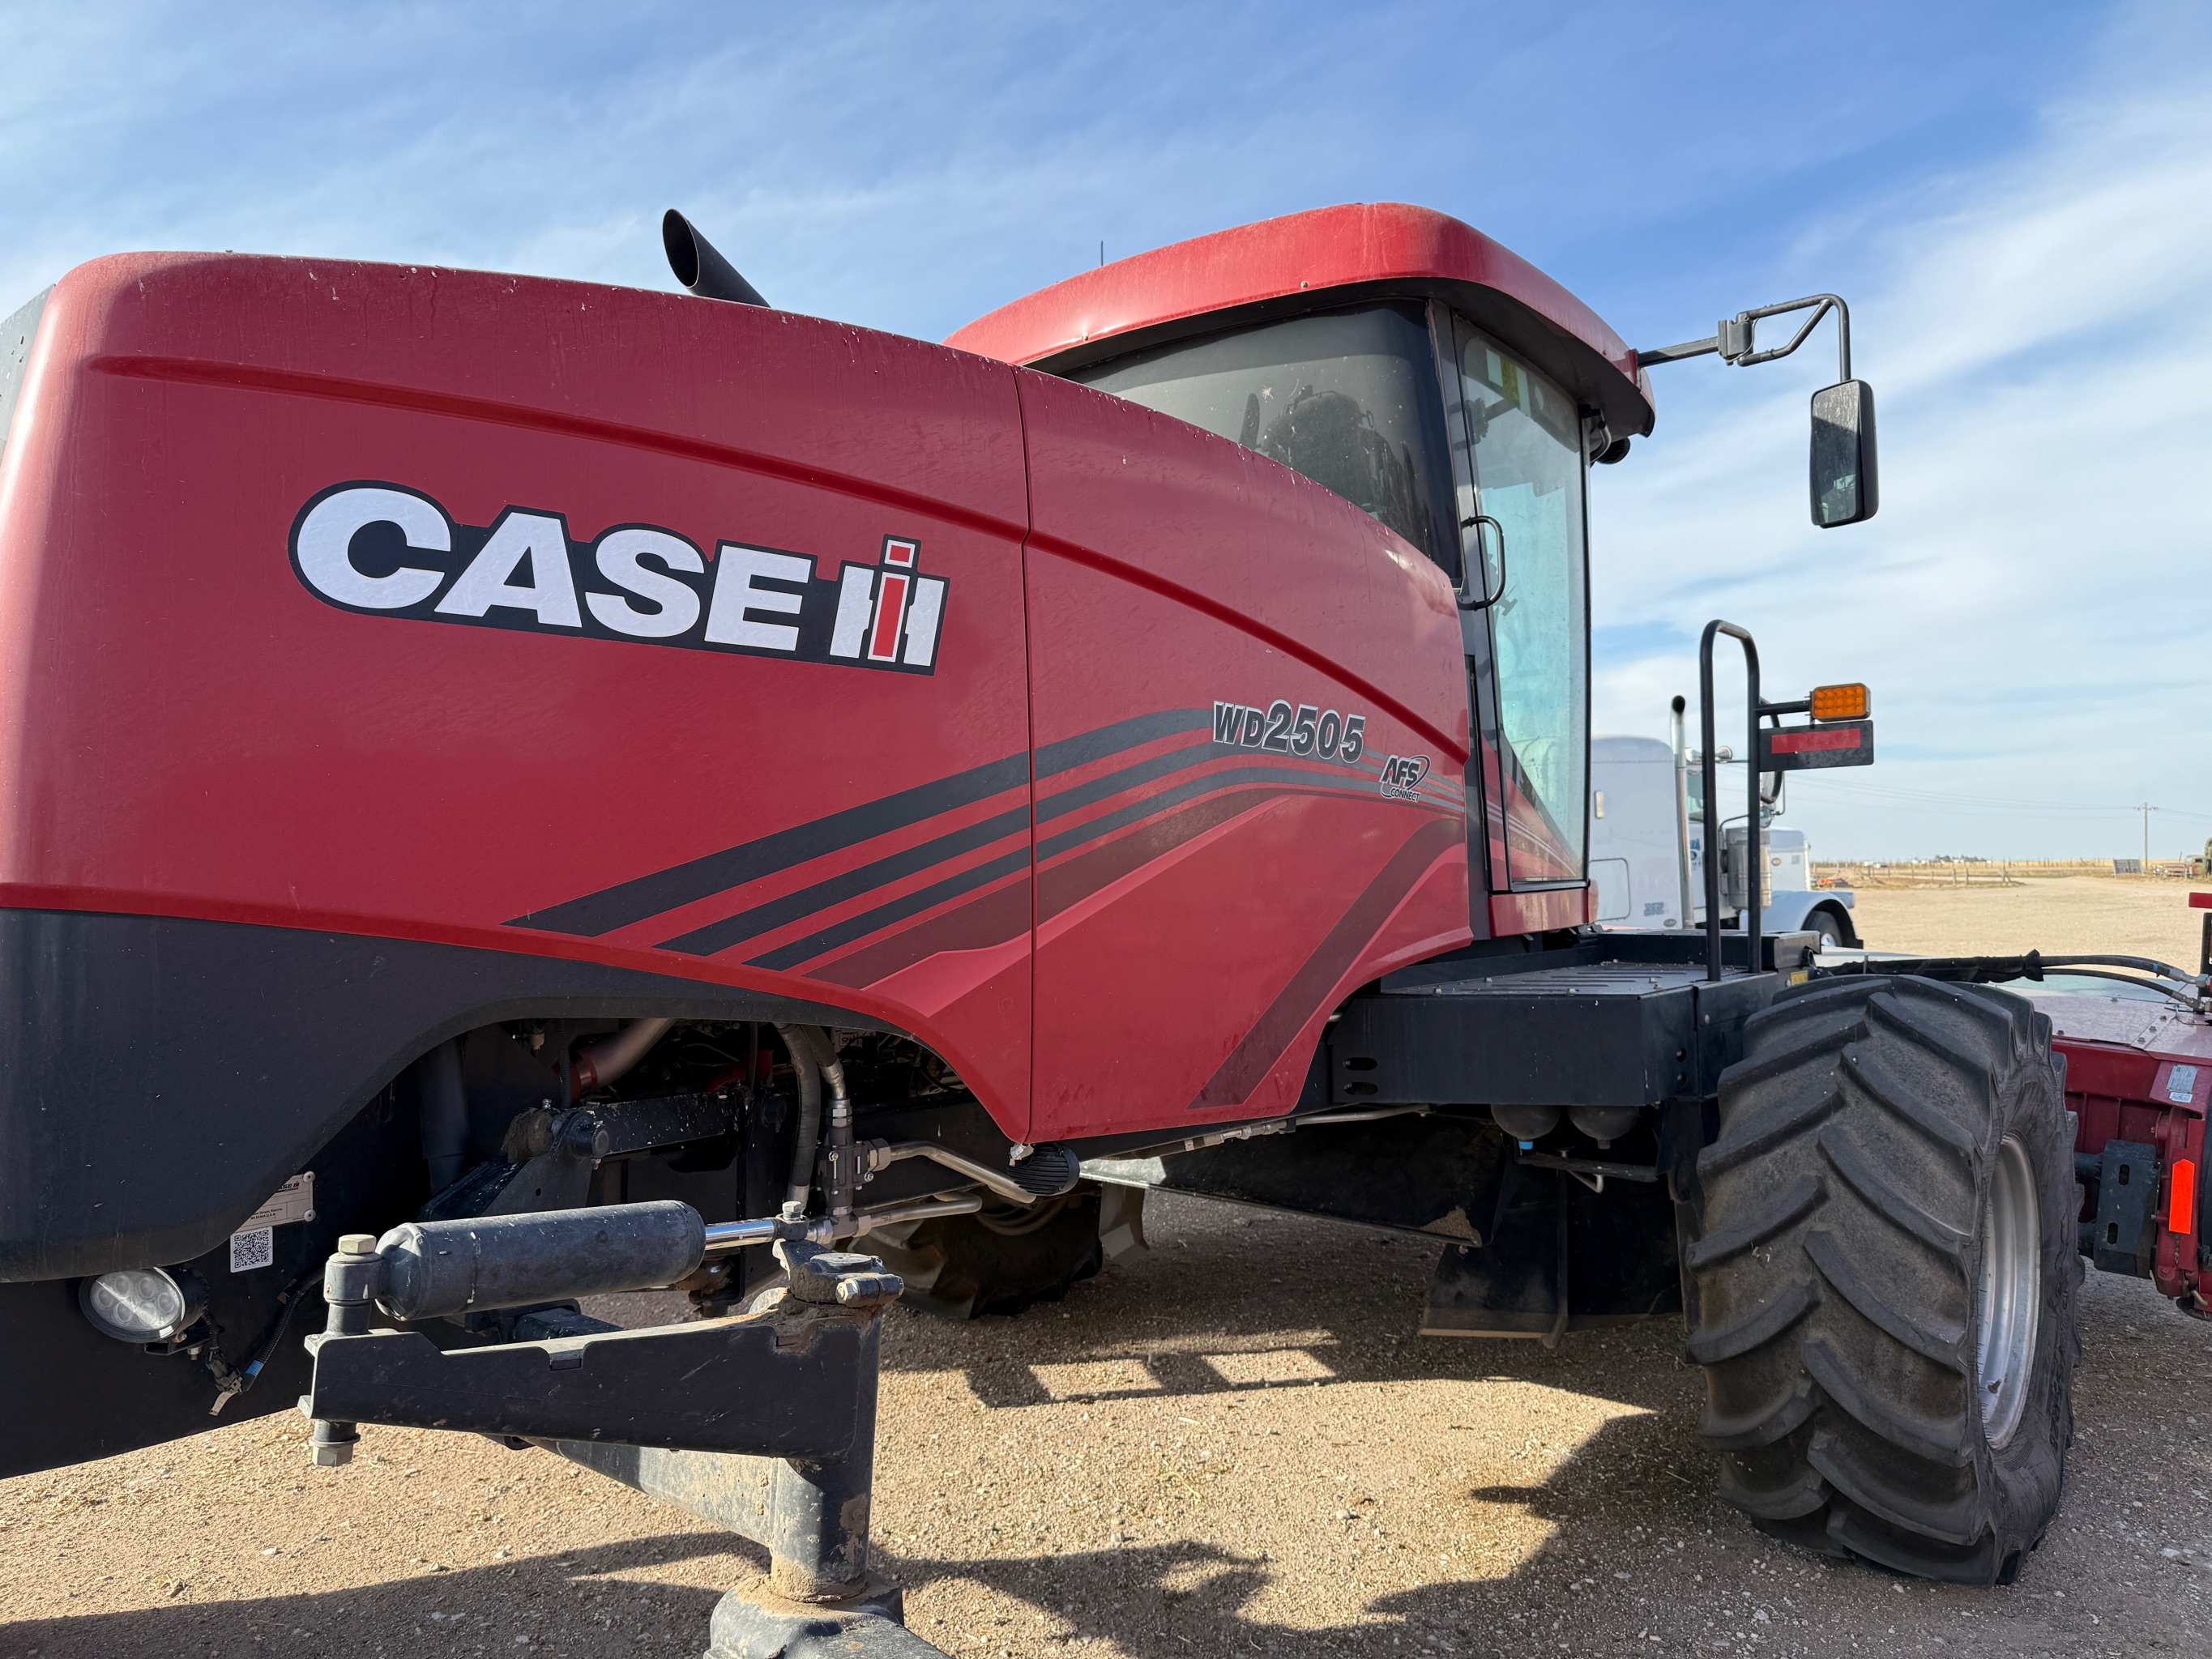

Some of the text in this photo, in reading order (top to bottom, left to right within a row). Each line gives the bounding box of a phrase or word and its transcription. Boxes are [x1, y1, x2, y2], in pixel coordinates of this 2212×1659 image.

[295, 485, 813, 652] CASE
[1213, 699, 1366, 763] WD2505
[1380, 755, 1420, 787] AFS
[1390, 787, 1420, 802] CONNECT
